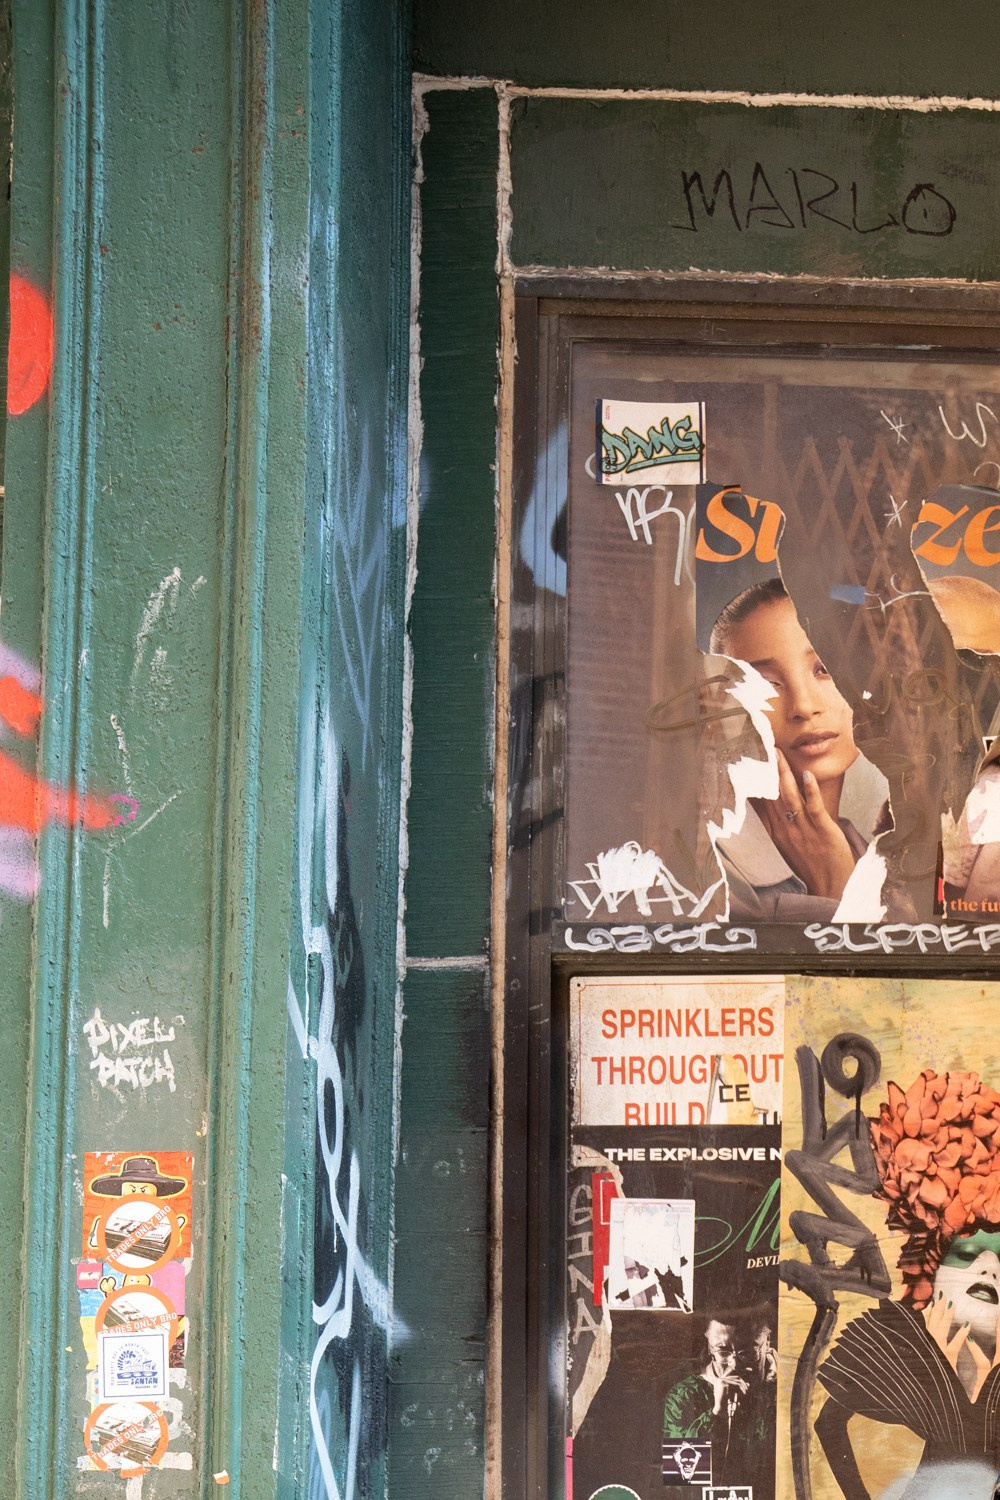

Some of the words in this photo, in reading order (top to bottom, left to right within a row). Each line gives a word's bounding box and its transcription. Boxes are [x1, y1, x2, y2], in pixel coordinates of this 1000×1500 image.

[671, 162, 957, 237] MARLO
[601, 414, 703, 474] DANG
[950, 898, 977, 912] the
[601, 1007, 775, 1039] SPRINKLERS
[604, 1148, 646, 1162] THE
[649, 1147, 767, 1162] EXPLOSIVE
[105, 1234, 137, 1263] TRADES
[134, 1218, 155, 1240] ONLY
[155, 1204, 171, 1221] BRO
[100, 1321, 133, 1335] RADES
[133, 1316, 158, 1329] ONLY
[160, 1311, 178, 1323] BRO
